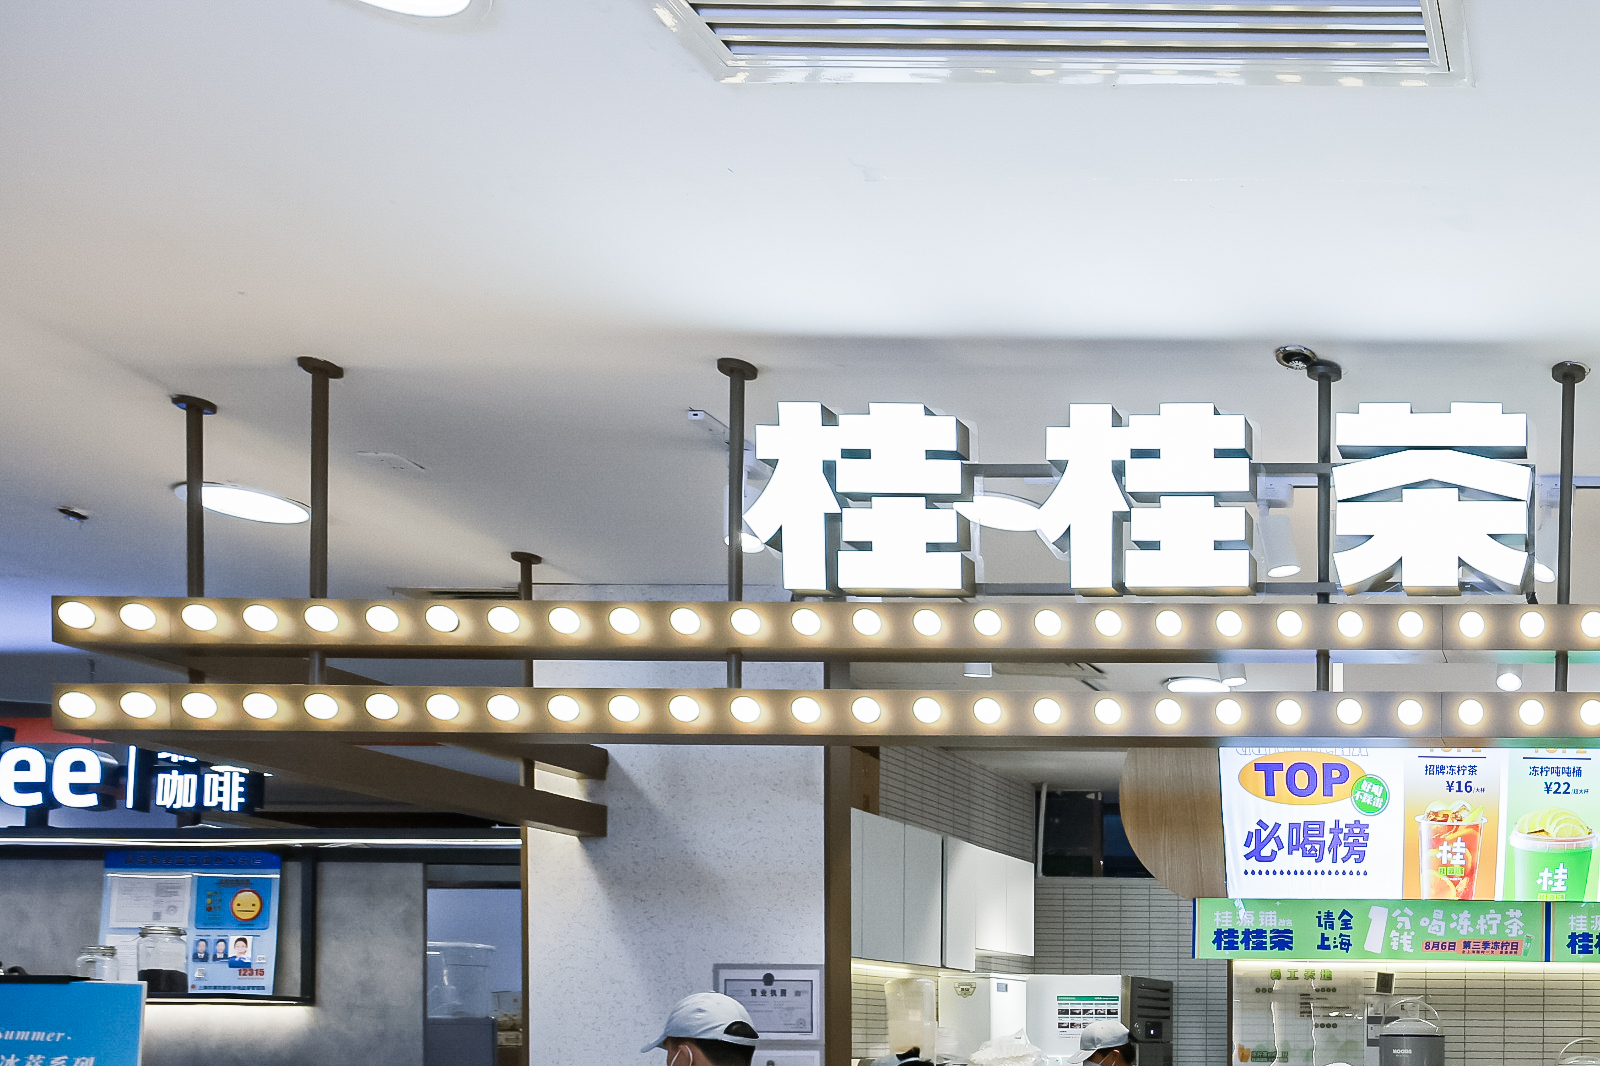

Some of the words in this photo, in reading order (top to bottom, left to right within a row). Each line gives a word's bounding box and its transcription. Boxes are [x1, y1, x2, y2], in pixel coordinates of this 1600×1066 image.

[1254, 762, 1350, 798] TOP
[1424, 764, 1478, 776] 招牌冻柠茶
[1528, 765, 1583, 778] 冻柠吨吨桶
[156, 769, 246, 812] 咖啡
[1243, 819, 1370, 864] 必喝榜
[1436, 836, 1466, 865] 桂
[1536, 863, 1568, 892] 桂
[1315, 908, 1355, 932] 请全
[1419, 908, 1525, 938] 喝冻柠茶
[1316, 932, 1353, 954] 上海
[1424, 941, 1457, 951] 8月6日
[1462, 940, 1519, 950] 第三季冻柠日
[237, 967, 265, 977] 12315
[1270, 968, 1333, 981] 员工天地
